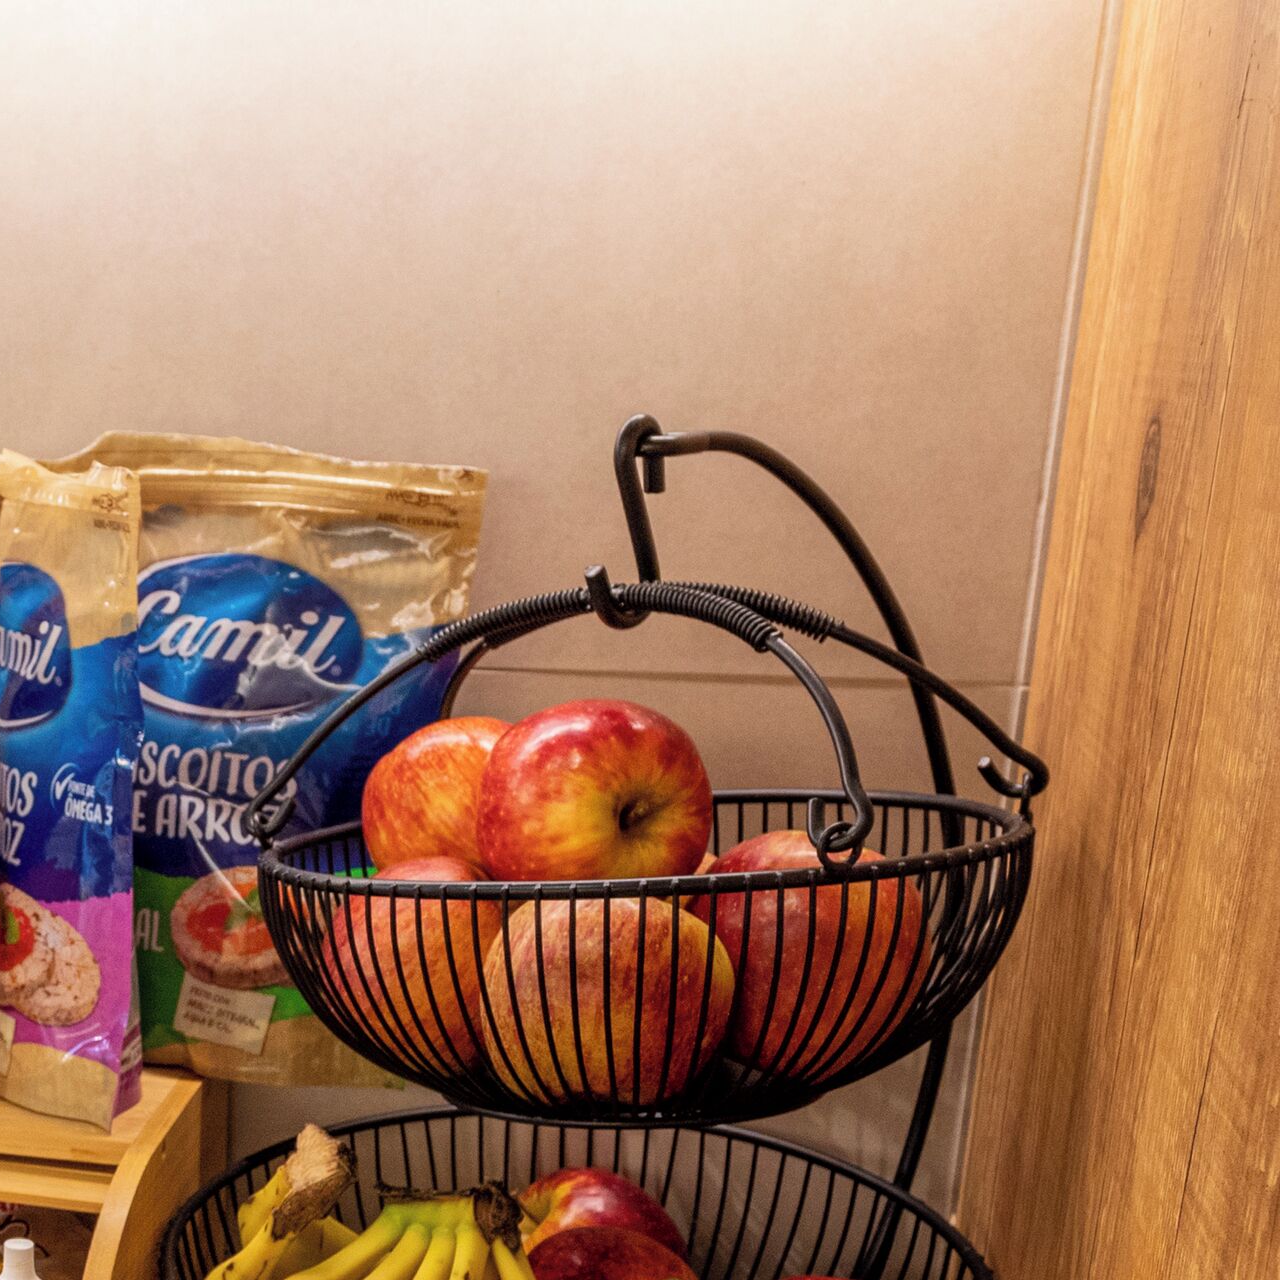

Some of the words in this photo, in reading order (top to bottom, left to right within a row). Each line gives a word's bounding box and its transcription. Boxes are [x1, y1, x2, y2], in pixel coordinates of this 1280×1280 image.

[138, 589, 344, 676] Camil
[64, 796, 104, 823] ÔMEGA
[102, 806, 114, 827] 3
